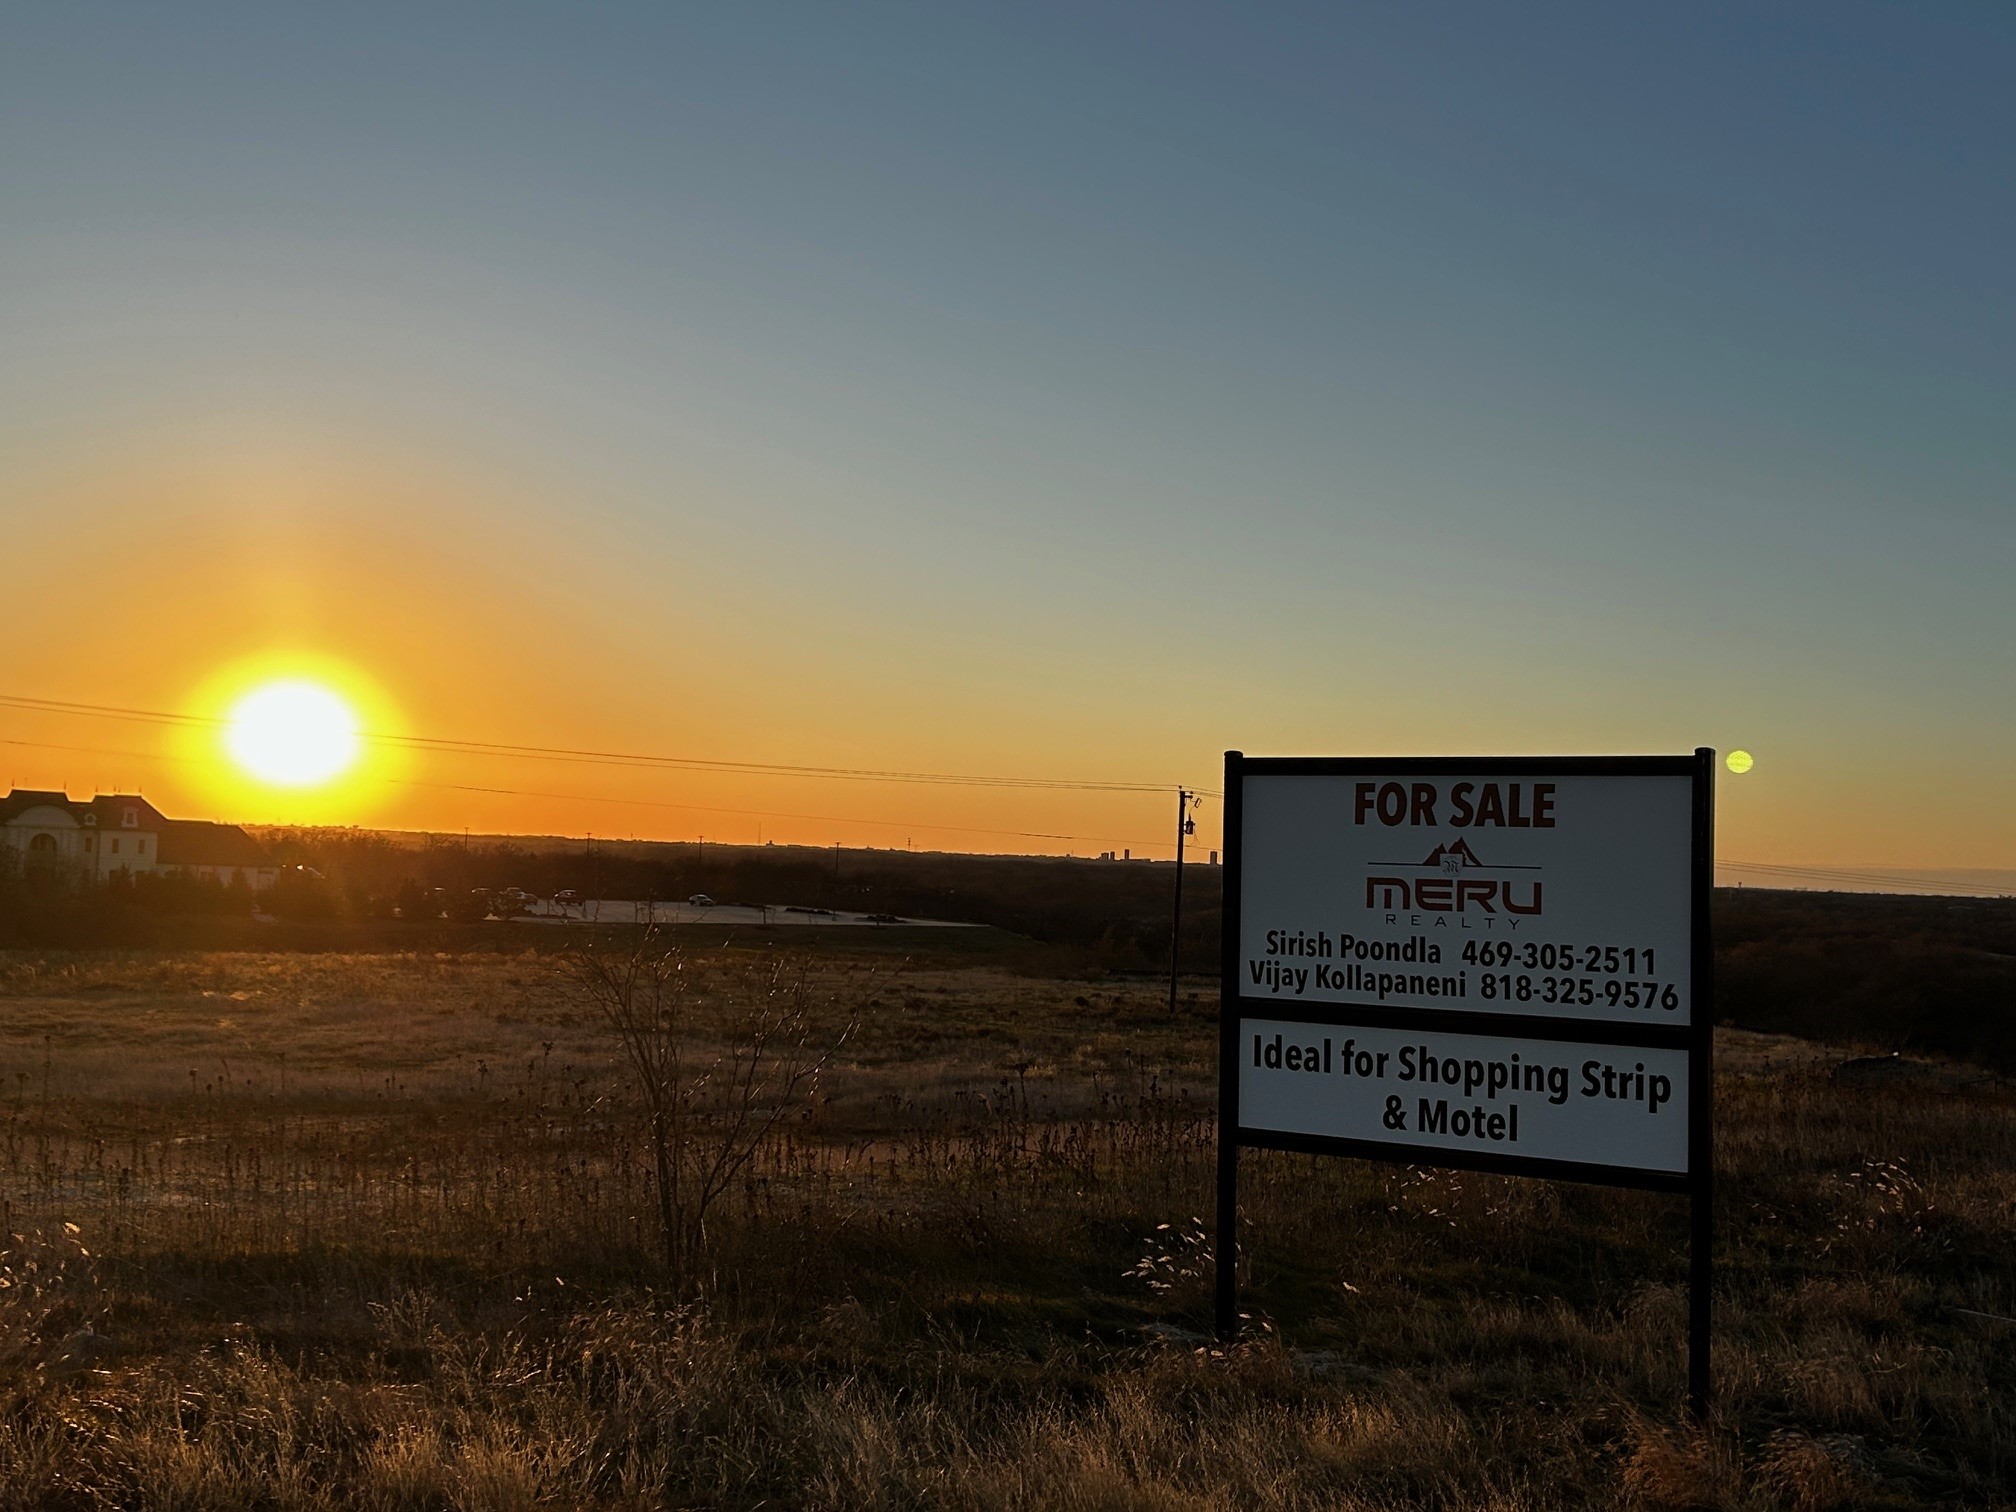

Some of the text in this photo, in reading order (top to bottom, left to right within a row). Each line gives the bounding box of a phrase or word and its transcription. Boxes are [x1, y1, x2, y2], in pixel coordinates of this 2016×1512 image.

[1354, 782, 1556, 828] FOR SALE
[1366, 876, 1542, 915] MERU
[1385, 913, 1521, 930] REALTY
[1265, 930, 1655, 975] Sirish Poondla 469-305-2511
[1249, 960, 1679, 1011] Vijay Kollapaneni 818-325-9576
[1253, 1034, 1671, 1113] Ideal for Shopping Strip
[1382, 1094, 1518, 1141] & Motel
